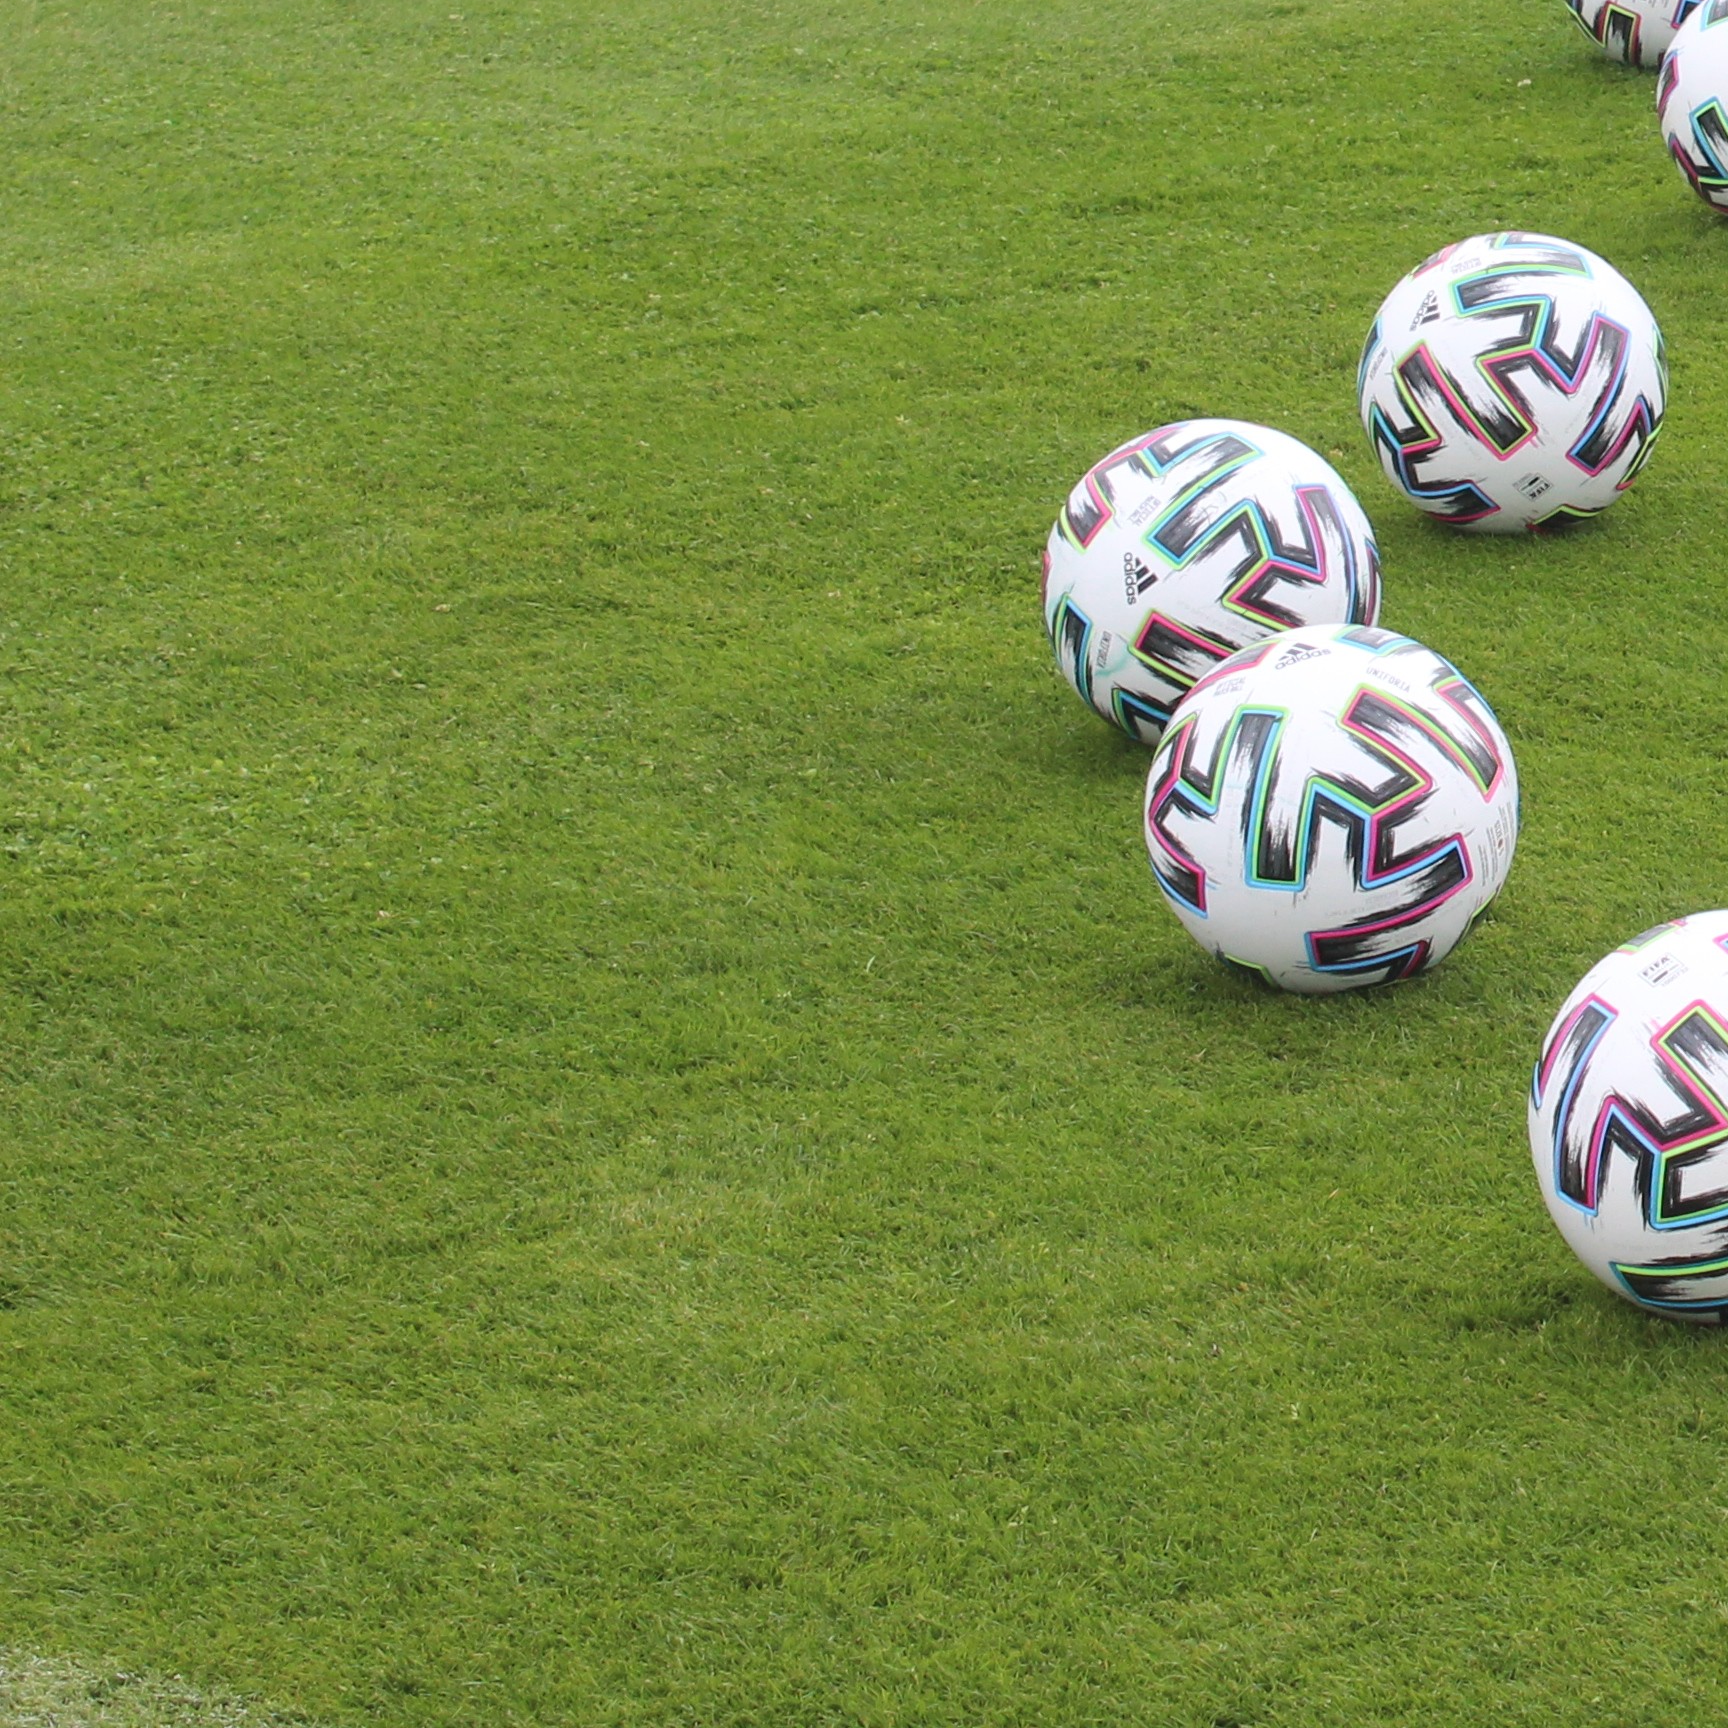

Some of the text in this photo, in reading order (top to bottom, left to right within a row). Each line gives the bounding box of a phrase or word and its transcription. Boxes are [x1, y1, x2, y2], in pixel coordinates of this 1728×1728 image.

[1409, 289, 1435, 332] adidas
[1123, 552, 1137, 606] adidas
[1274, 647, 1332, 671] adidas
[1365, 666, 1411, 693] UNIFORIA
